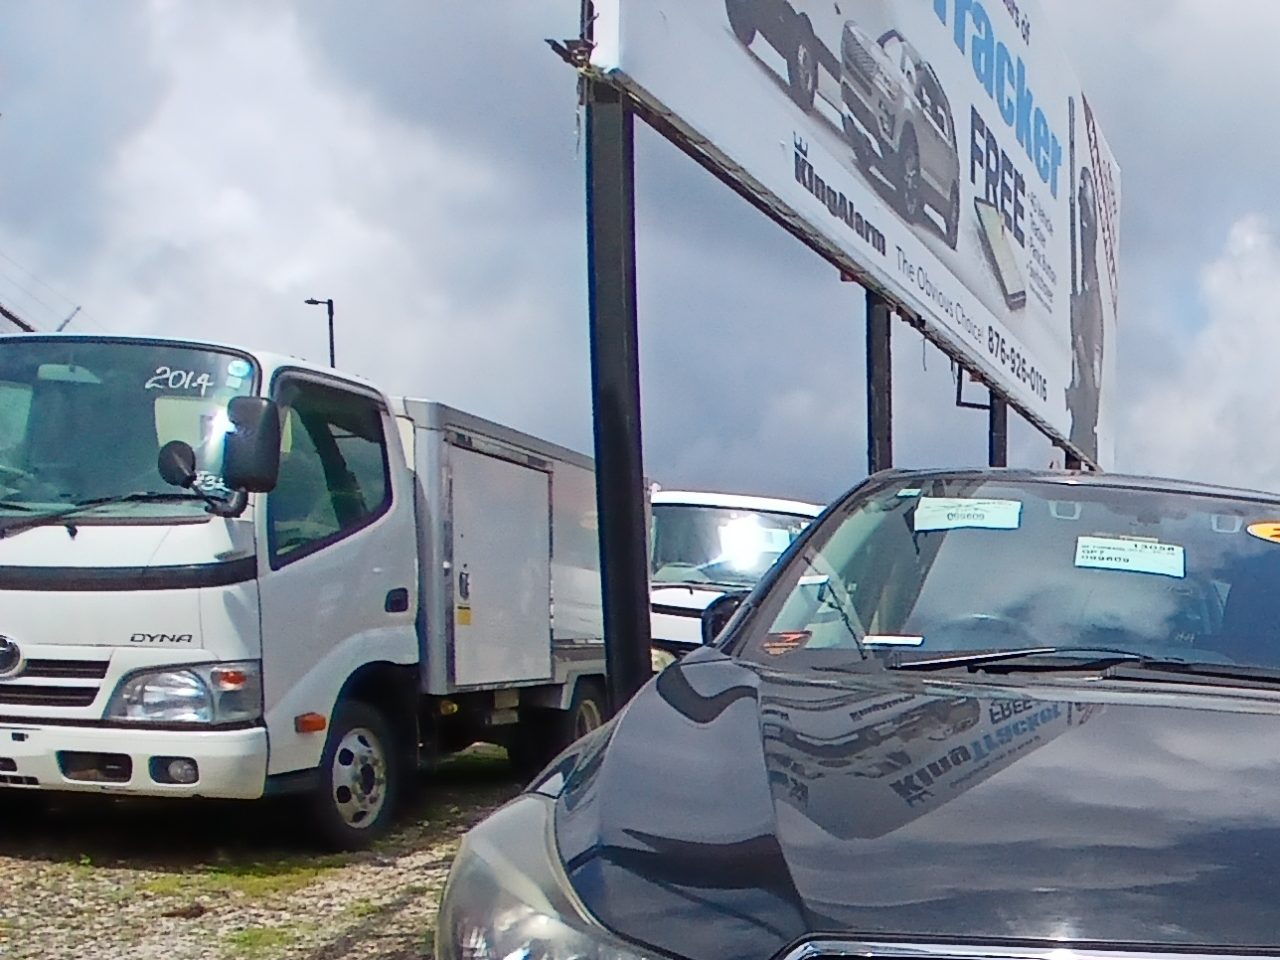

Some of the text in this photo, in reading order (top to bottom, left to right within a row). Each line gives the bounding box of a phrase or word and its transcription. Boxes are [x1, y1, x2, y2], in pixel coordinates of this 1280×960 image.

[971, 104, 1026, 248] FREE
[896, 245, 914, 283] The
[916, 266, 954, 318] Obvious
[144, 366, 214, 398] 2014
[129, 633, 193, 643] DYNA
